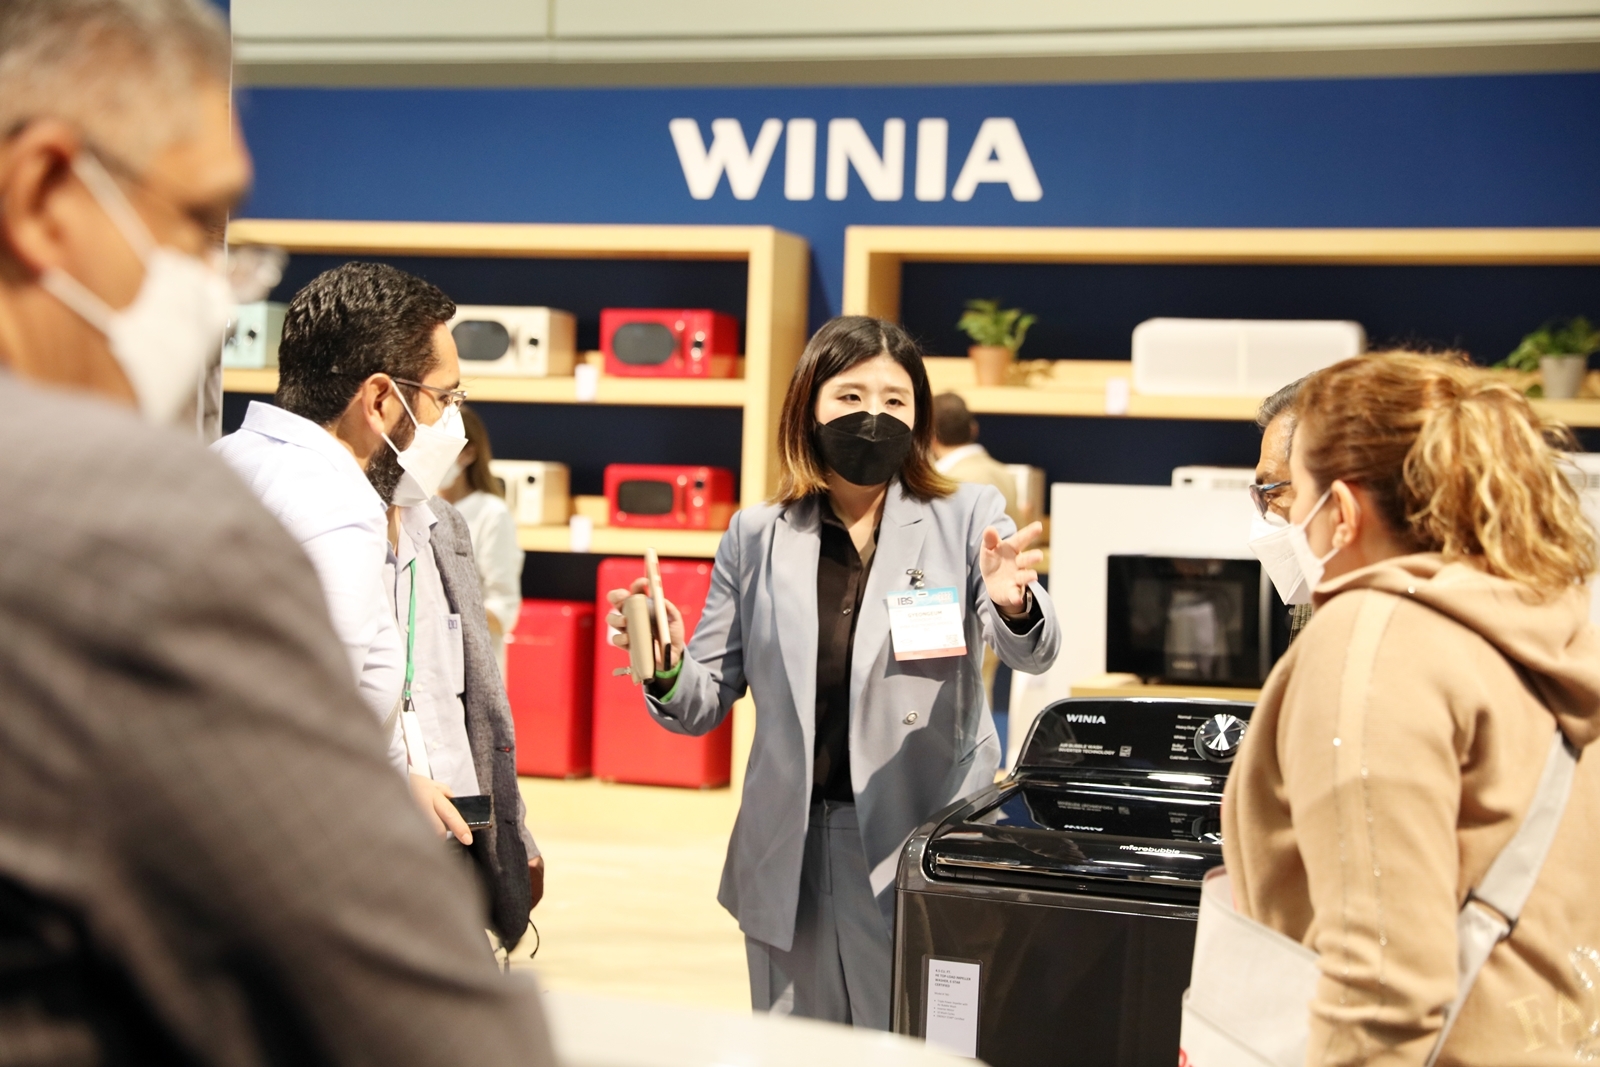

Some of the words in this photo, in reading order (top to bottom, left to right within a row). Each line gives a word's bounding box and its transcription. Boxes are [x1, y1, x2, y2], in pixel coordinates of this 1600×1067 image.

[669, 117, 1043, 202] WINIA
[897, 596, 914, 606] IBS
[1066, 713, 1106, 725] WINIA
